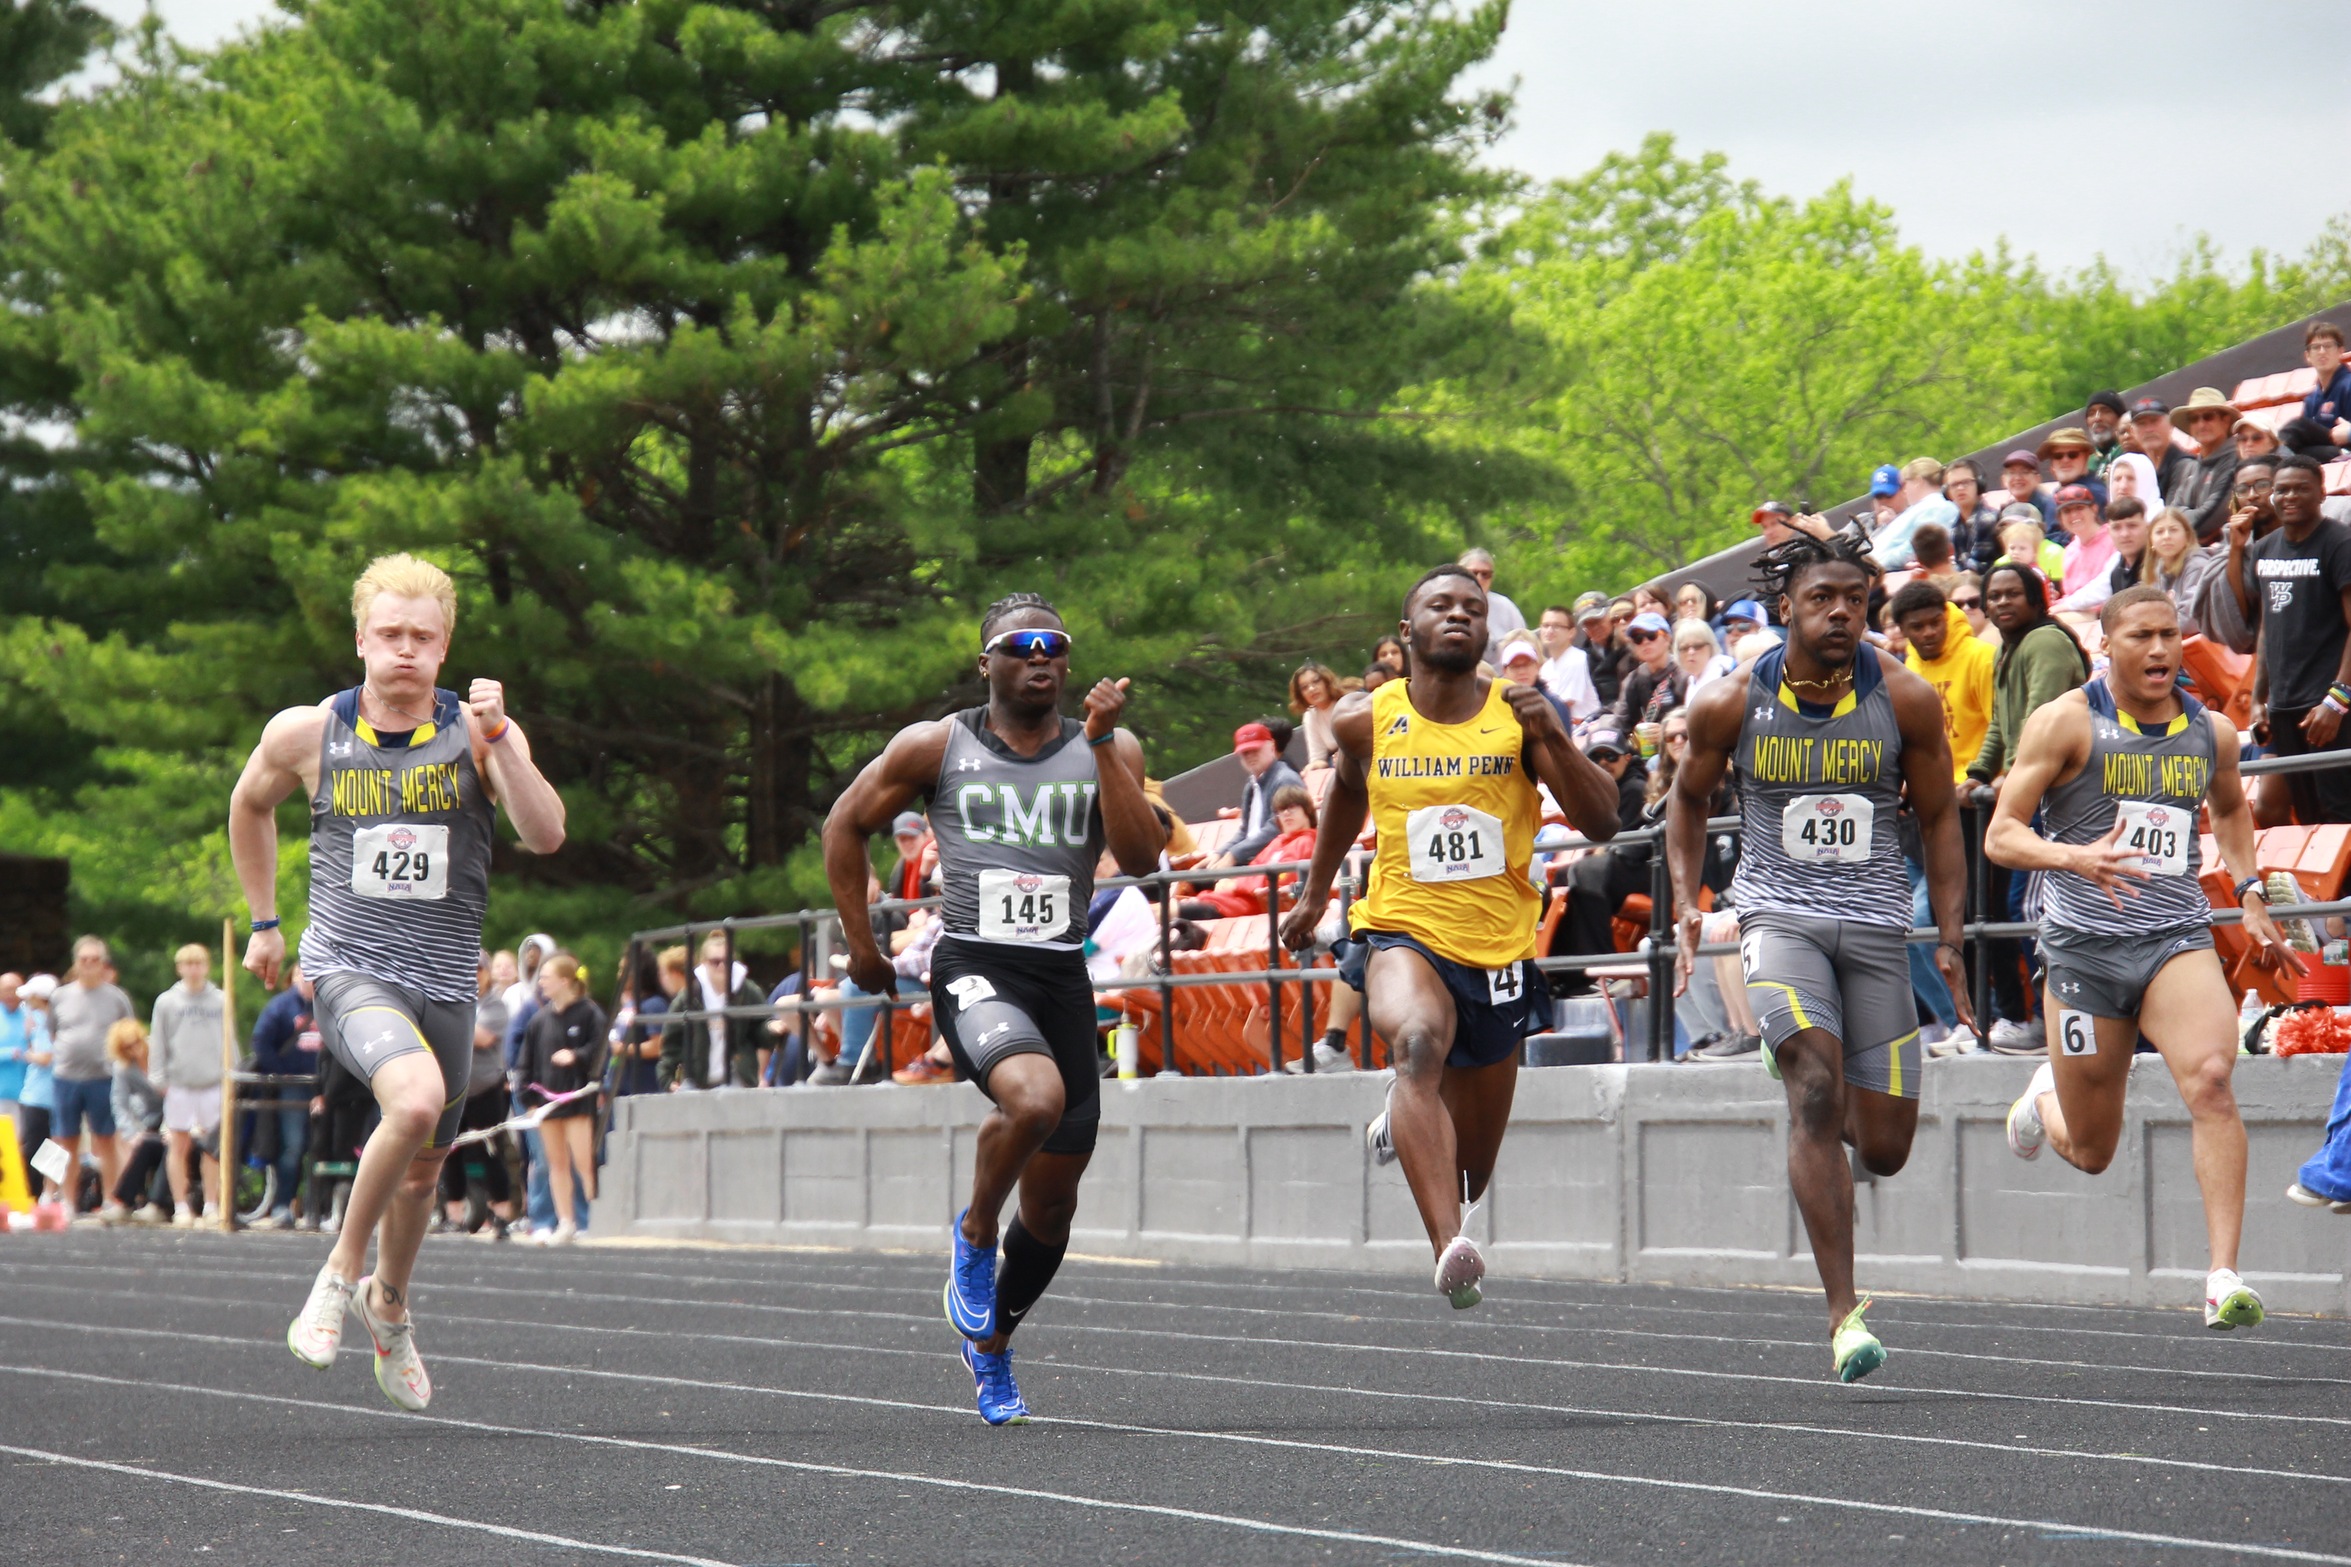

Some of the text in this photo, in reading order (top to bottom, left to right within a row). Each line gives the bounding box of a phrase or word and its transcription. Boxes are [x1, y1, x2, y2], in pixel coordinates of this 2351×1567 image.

[2257, 558, 2320, 576] PERSPECTIVE.
[1378, 756, 1516, 777] WILLIAM PENN
[1753, 734, 1883, 783] MOUNT MERCY
[2103, 752, 2208, 798] MOUNT MERCY
[332, 763, 460, 816] MOUNT MERCY
[957, 781, 1097, 848] CMU
[1428, 830, 1484, 863] 481
[1801, 818, 1856, 845] 430
[2130, 826, 2176, 858] 403
[372, 850, 429, 881] 429
[1001, 894, 1053, 924] 145
[1494, 962, 1518, 997] 4
[2065, 1015, 2086, 1053] 6
